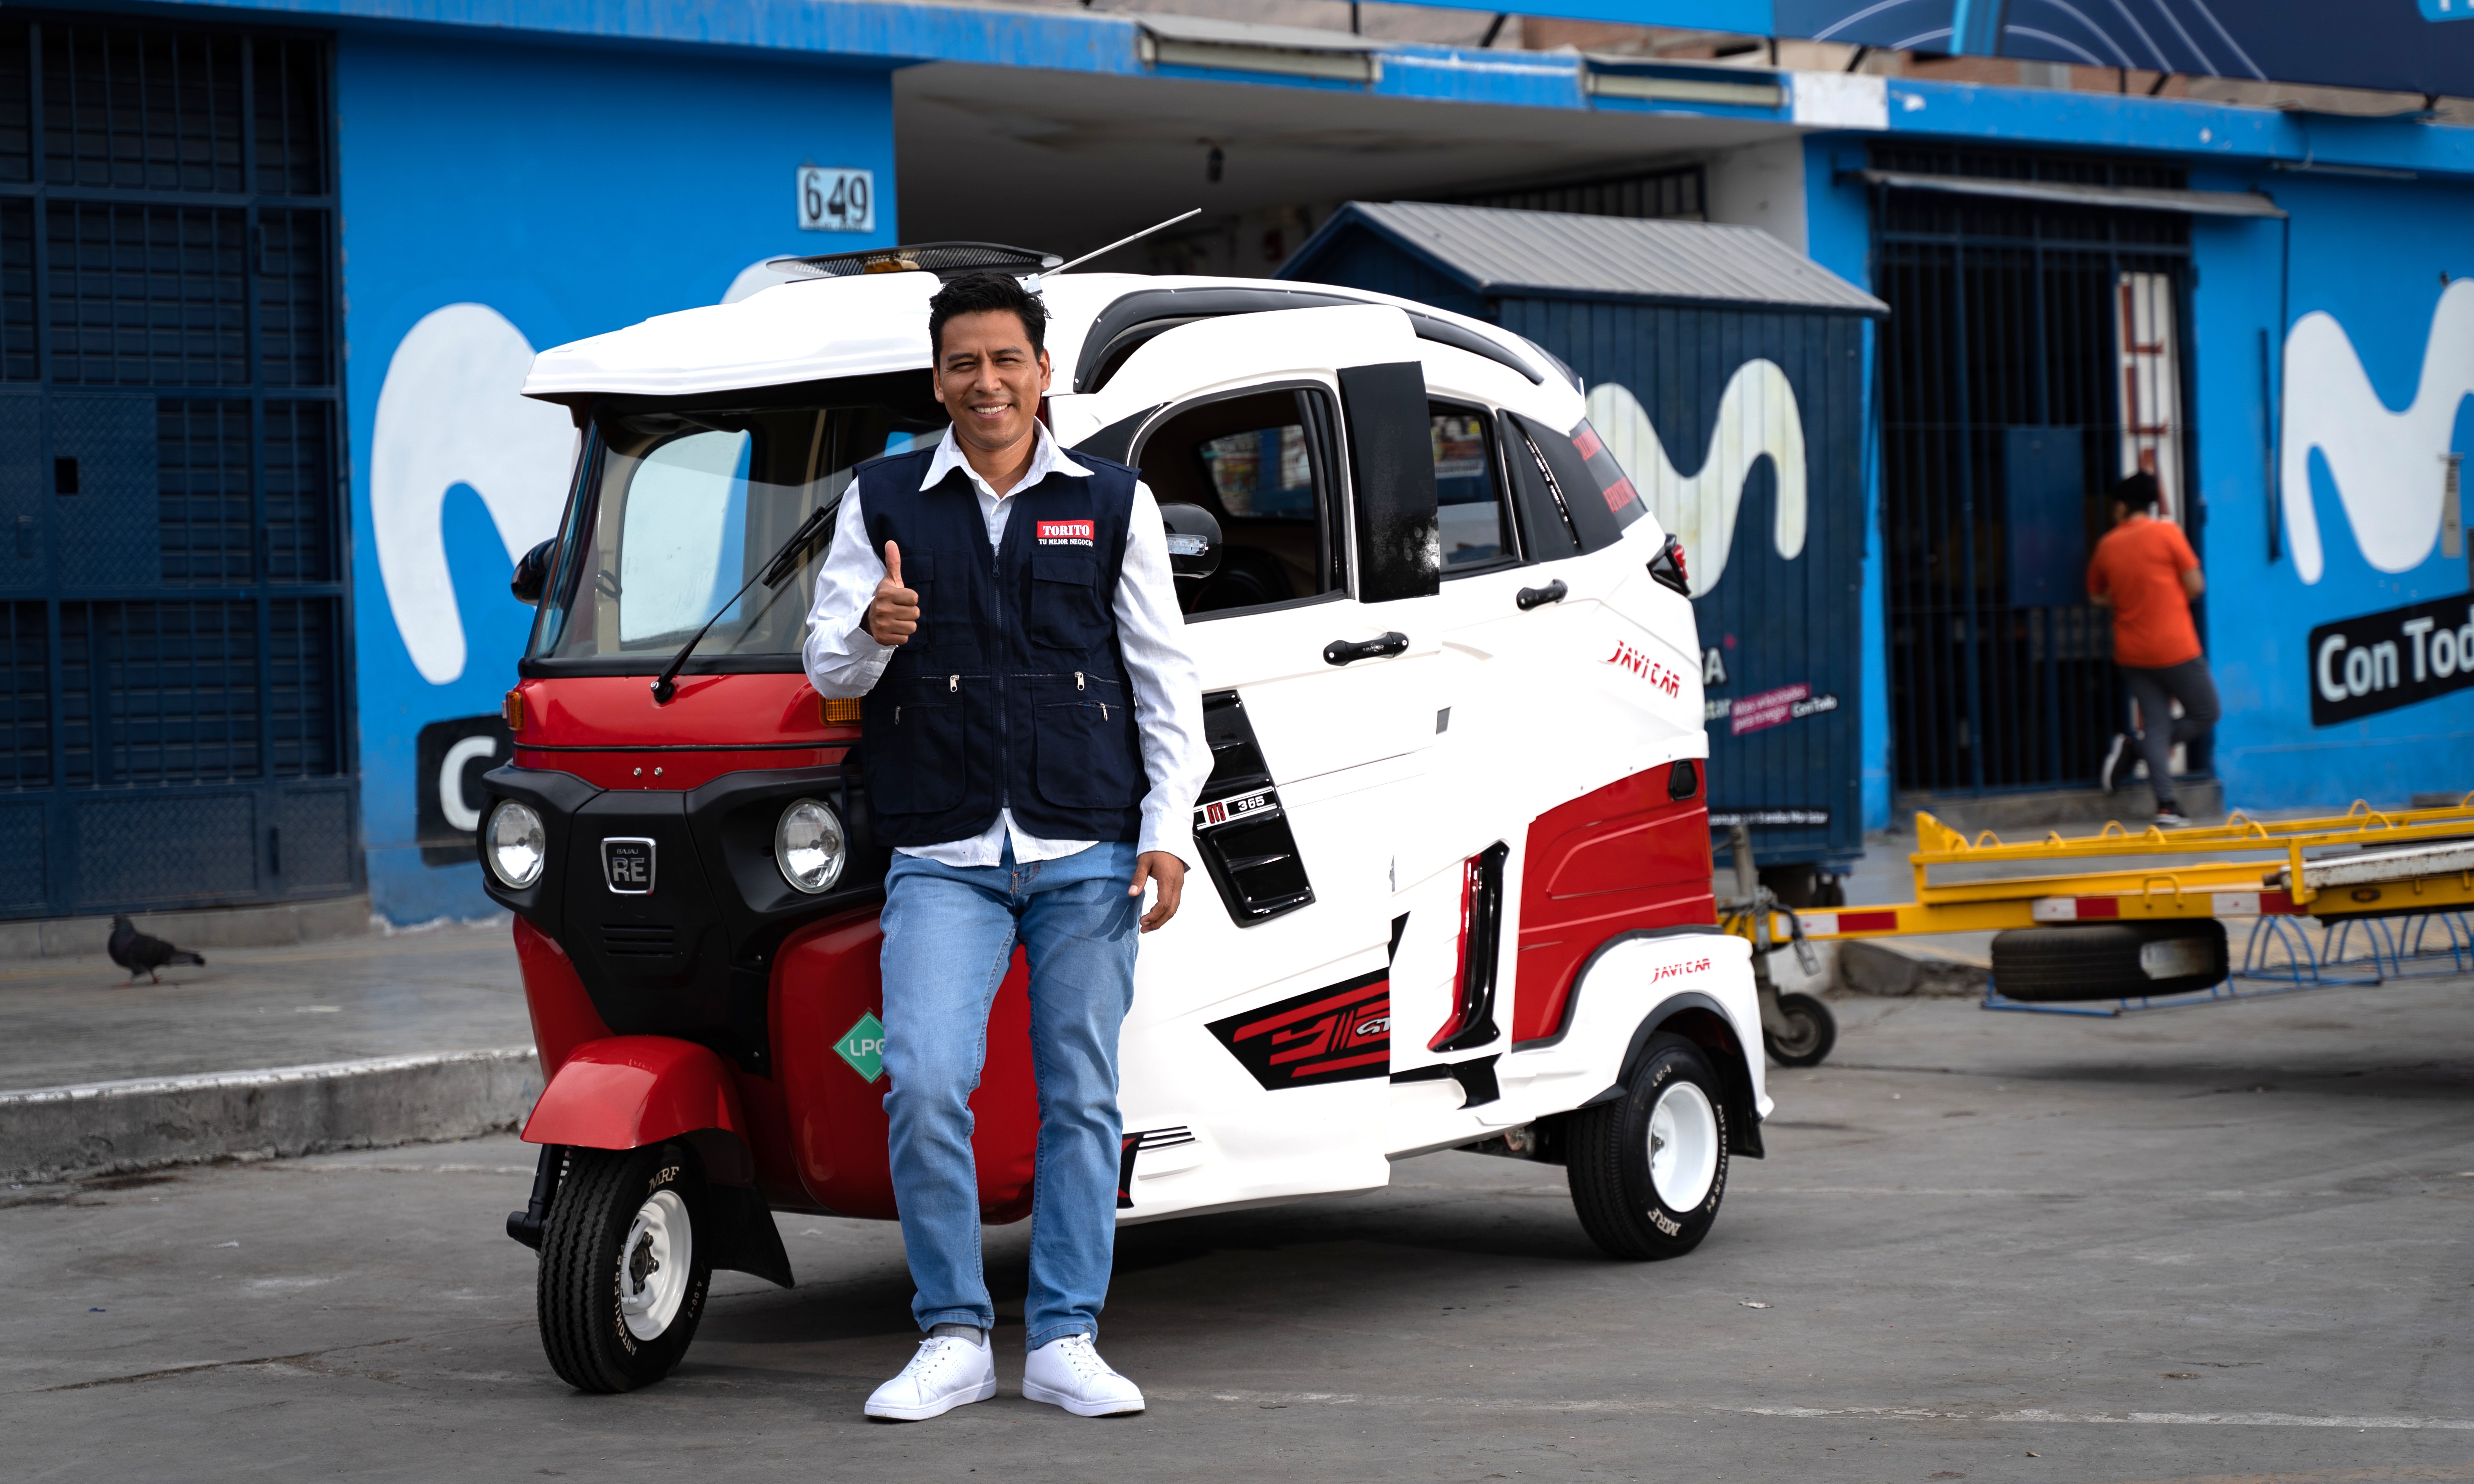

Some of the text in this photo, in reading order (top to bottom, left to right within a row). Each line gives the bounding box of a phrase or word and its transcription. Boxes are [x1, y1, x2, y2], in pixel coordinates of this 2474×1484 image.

[804, 169, 868, 223] 649
[1042, 524, 1090, 537] TORITO
[1070, 538, 1093, 547] NEGOCIO
[2317, 633, 2399, 702] Con
[439, 735, 498, 832] C
[1237, 795, 1265, 812] 365
[612, 857, 647, 882] RE
[647, 1166, 680, 1195] MRF
[1646, 1207, 1682, 1237] MRF
[614, 1272, 637, 1357] AUTOMILER
